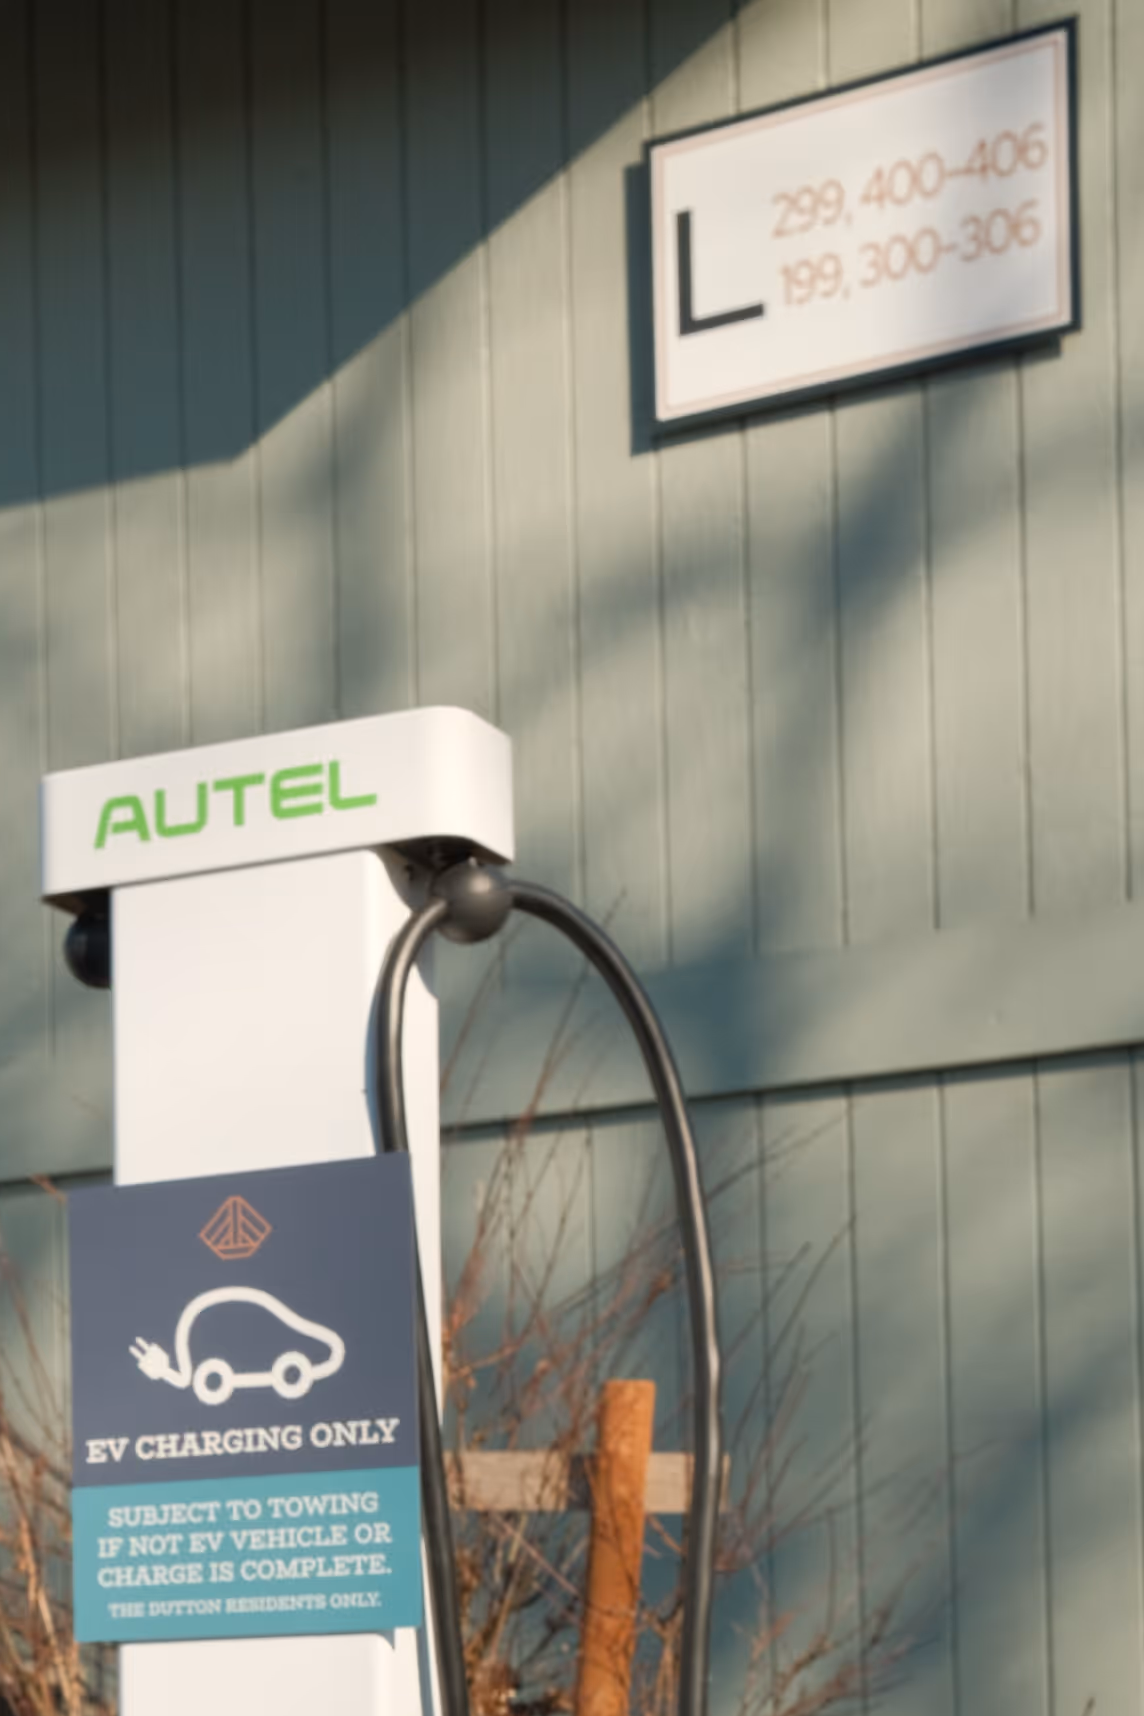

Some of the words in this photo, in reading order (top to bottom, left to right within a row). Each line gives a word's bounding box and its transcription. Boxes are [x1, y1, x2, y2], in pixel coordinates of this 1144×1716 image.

[676, 210, 765, 336] L
[93, 760, 378, 850] AUTEL
[86, 1437, 129, 1464] EV
[135, 1425, 303, 1460] CHARGING
[310, 1418, 400, 1448] ONLY
[108, 1501, 221, 1528] SUBJECT
[226, 1500, 262, 1522] TO
[267, 1492, 379, 1518] TOWING
[97, 1537, 123, 1558] IF
[129, 1534, 183, 1556] NOT
[189, 1532, 224, 1552] EV
[230, 1525, 347, 1550] VEHICLE
[354, 1523, 392, 1544] OR
[97, 1563, 203, 1588] CHARGE
[209, 1562, 235, 1582] IS
[240, 1554, 392, 1581] COMPLETE.
[108, 1602, 145, 1618] THE
[149, 1599, 221, 1616] DUTTON
[225, 1594, 326, 1614] RESIDENTS
